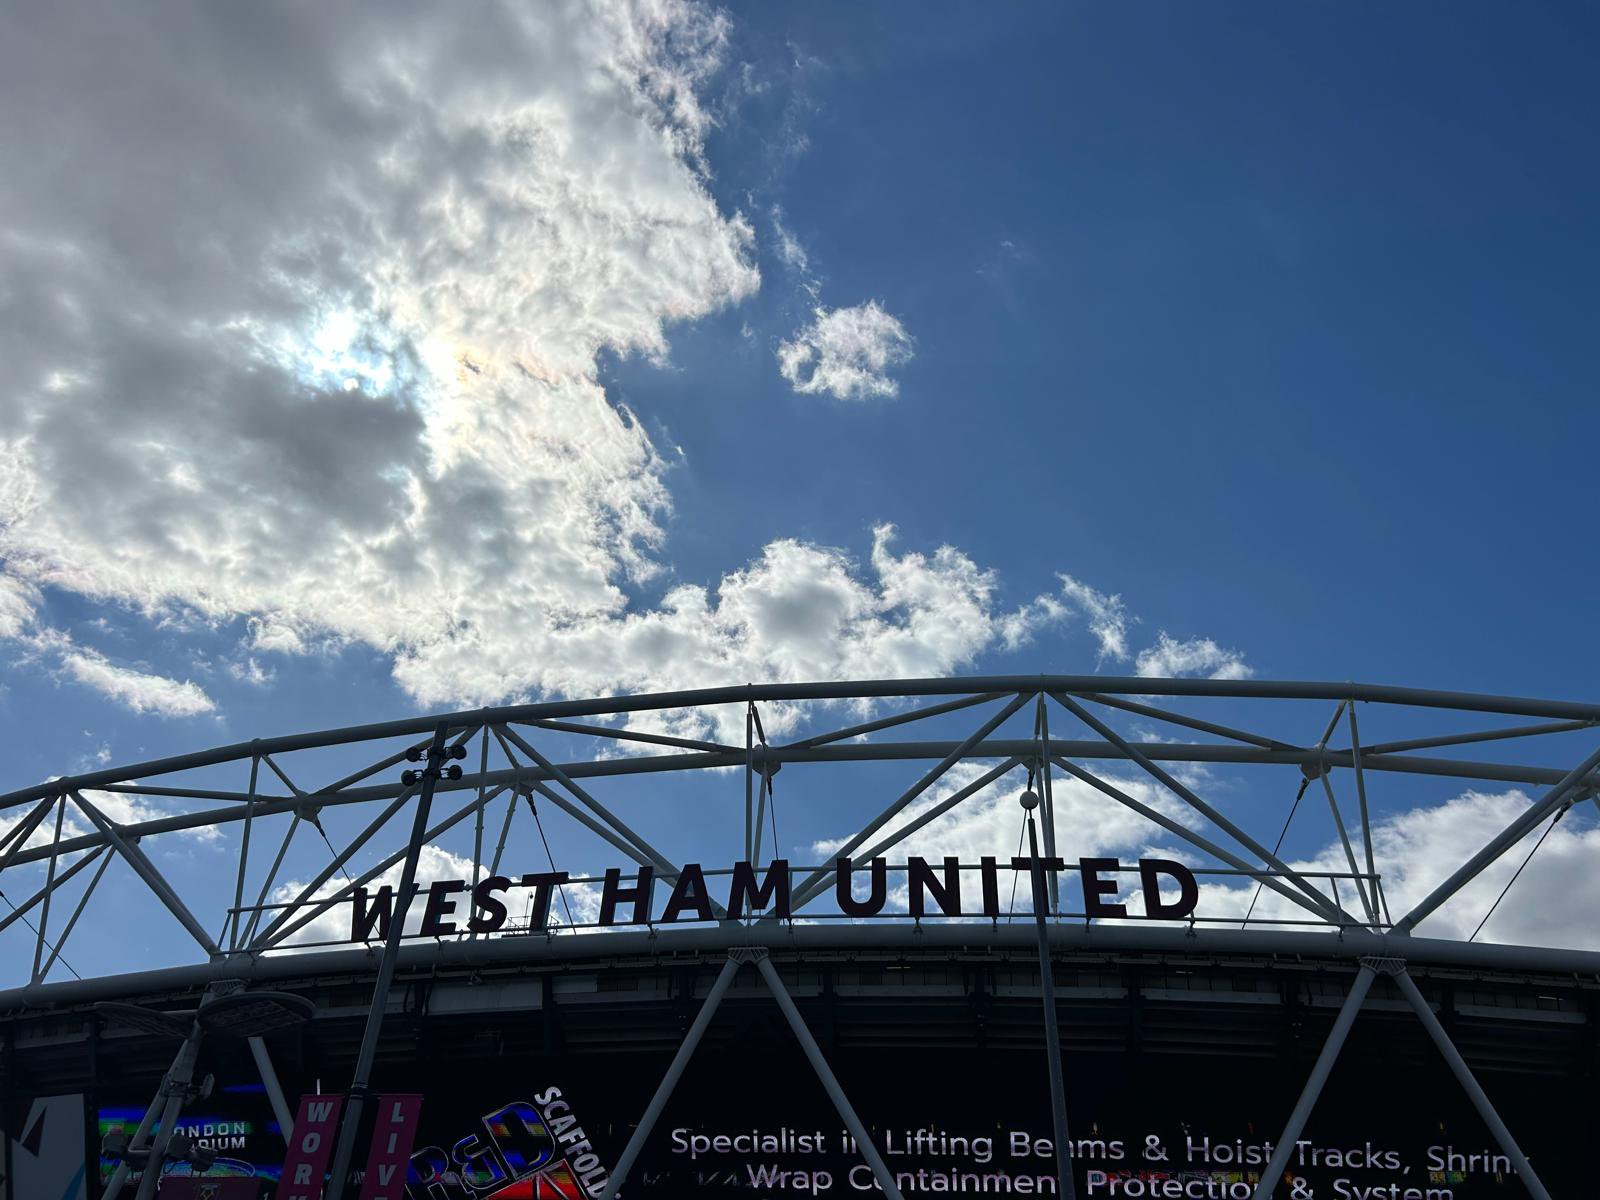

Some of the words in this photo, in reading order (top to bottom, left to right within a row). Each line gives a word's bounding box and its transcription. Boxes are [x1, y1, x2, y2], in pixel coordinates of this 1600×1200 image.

[351, 871, 569, 942] WEST
[600, 859, 790, 927] HAM
[836, 856, 1199, 920] UNITED
[288, 1102, 334, 1200] WOR
[373, 1102, 405, 1200] LIV
[534, 1086, 621, 1200] SCAFFOLD
[671, 1126, 828, 1160] Specialist
[885, 1128, 993, 1164] Lifting
[1009, 1131, 1126, 1160] Bems
[1143, 1134, 1170, 1162] &
[1186, 1135, 1273, 1166] Hoist
[1296, 1140, 1412, 1175] Tracks,
[746, 1163, 834, 1196] Wrap
[1289, 1176, 1315, 1200] &
[1331, 1178, 1455, 1200] System
